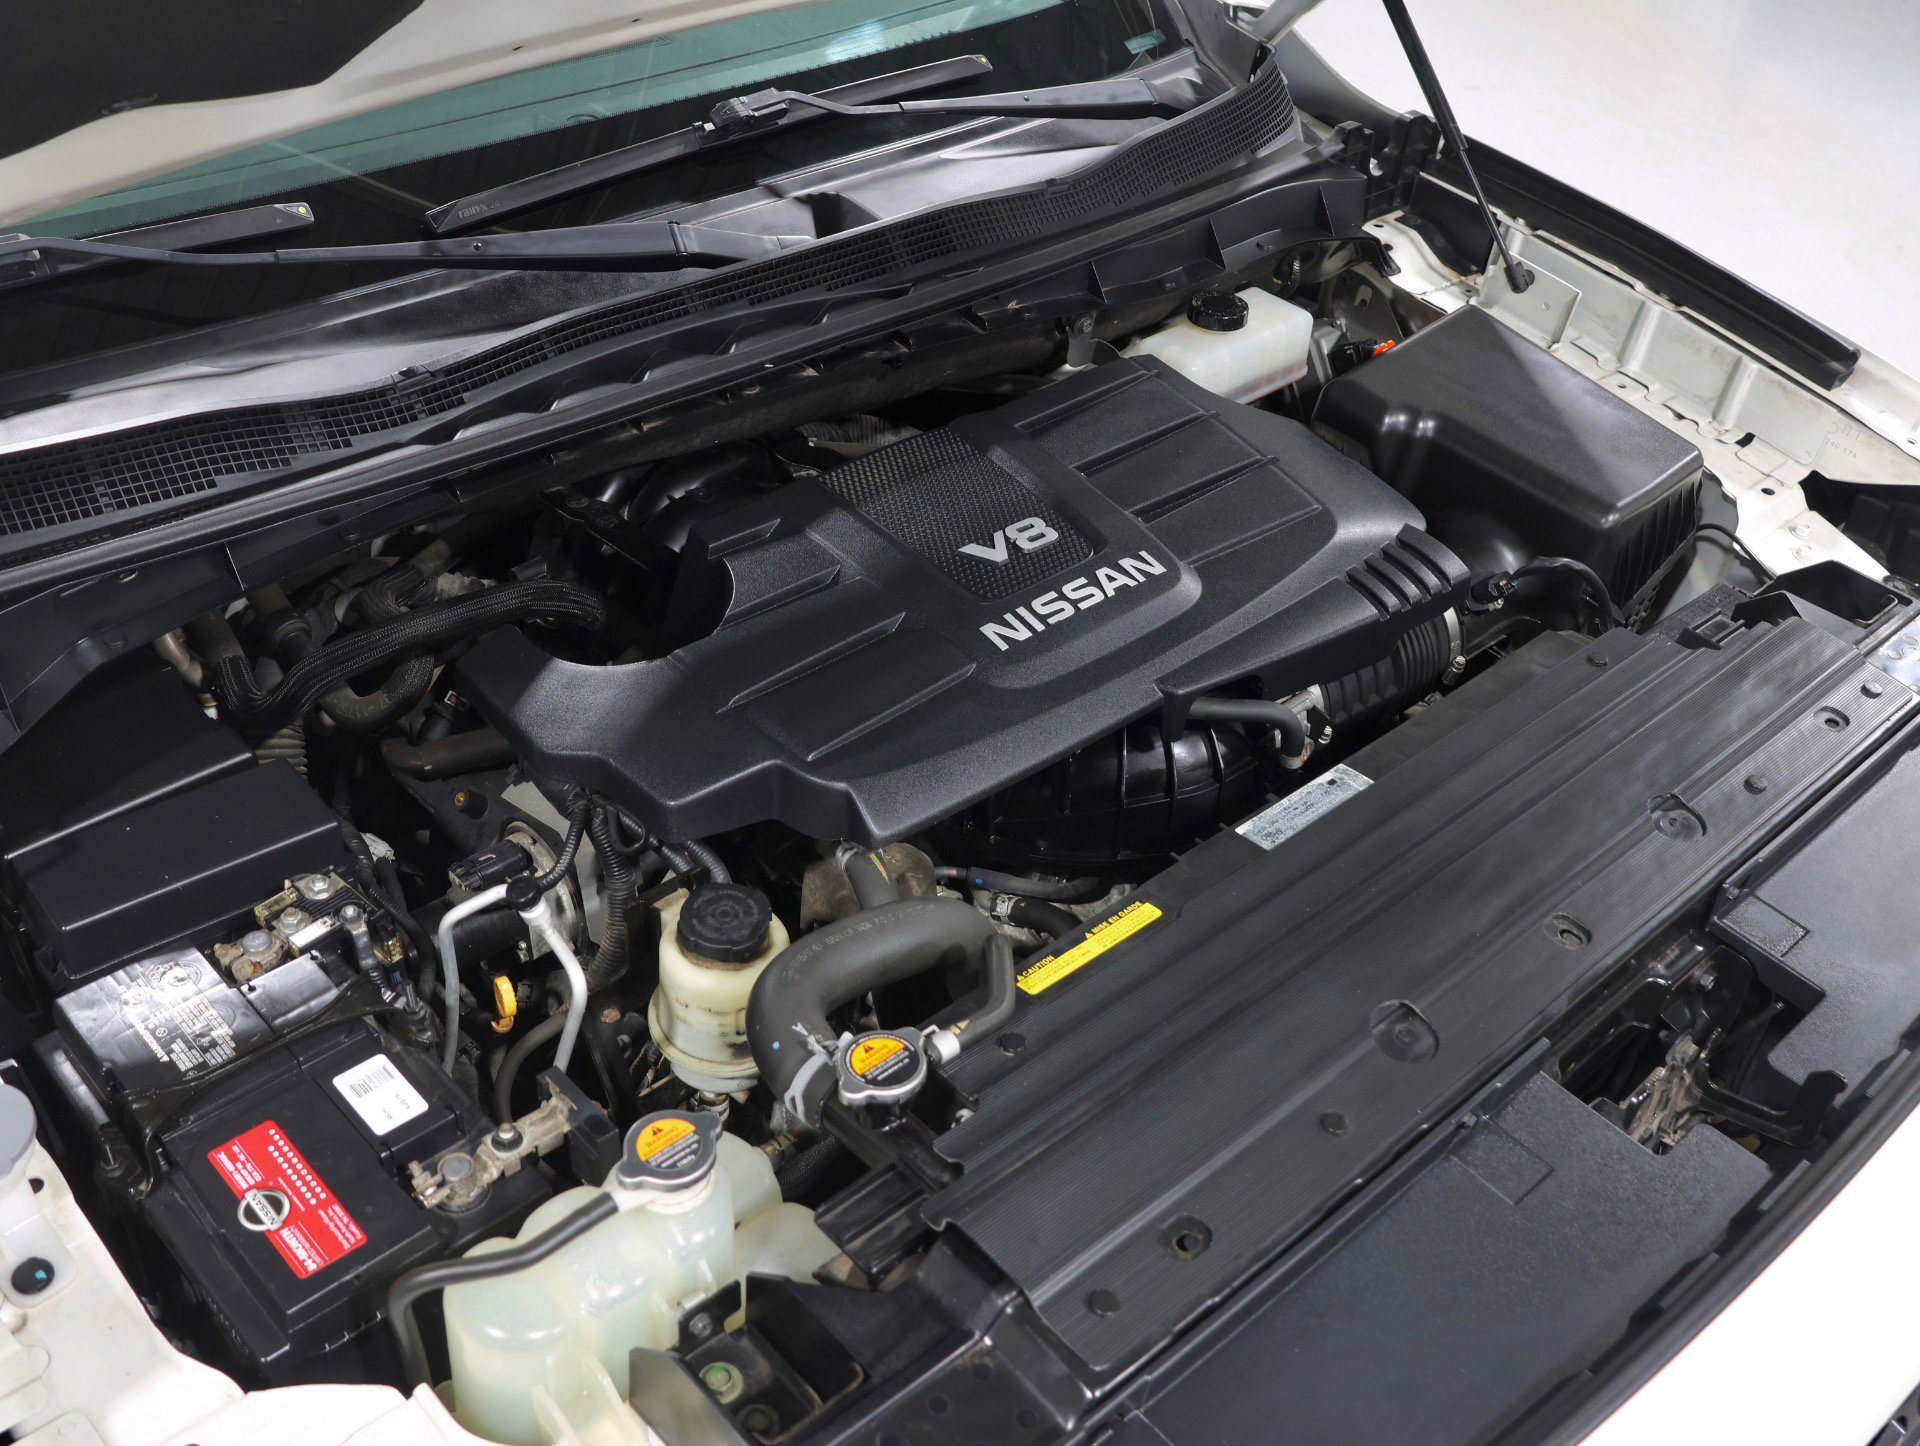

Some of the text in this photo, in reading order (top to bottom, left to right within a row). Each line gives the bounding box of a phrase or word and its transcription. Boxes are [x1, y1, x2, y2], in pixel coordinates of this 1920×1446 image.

[958, 517, 1059, 565] V8
[979, 550, 1167, 651] NISSAN
[1091, 900, 1142, 933] MISE EN GARDE
[1022, 954, 1054, 977] CAUTION
[859, 1044, 888, 1062] WARNING
[646, 1125, 678, 1147] WARNING
[248, 1192, 278, 1226] NISSAN
[278, 1227, 316, 1273] 84-MONTH
